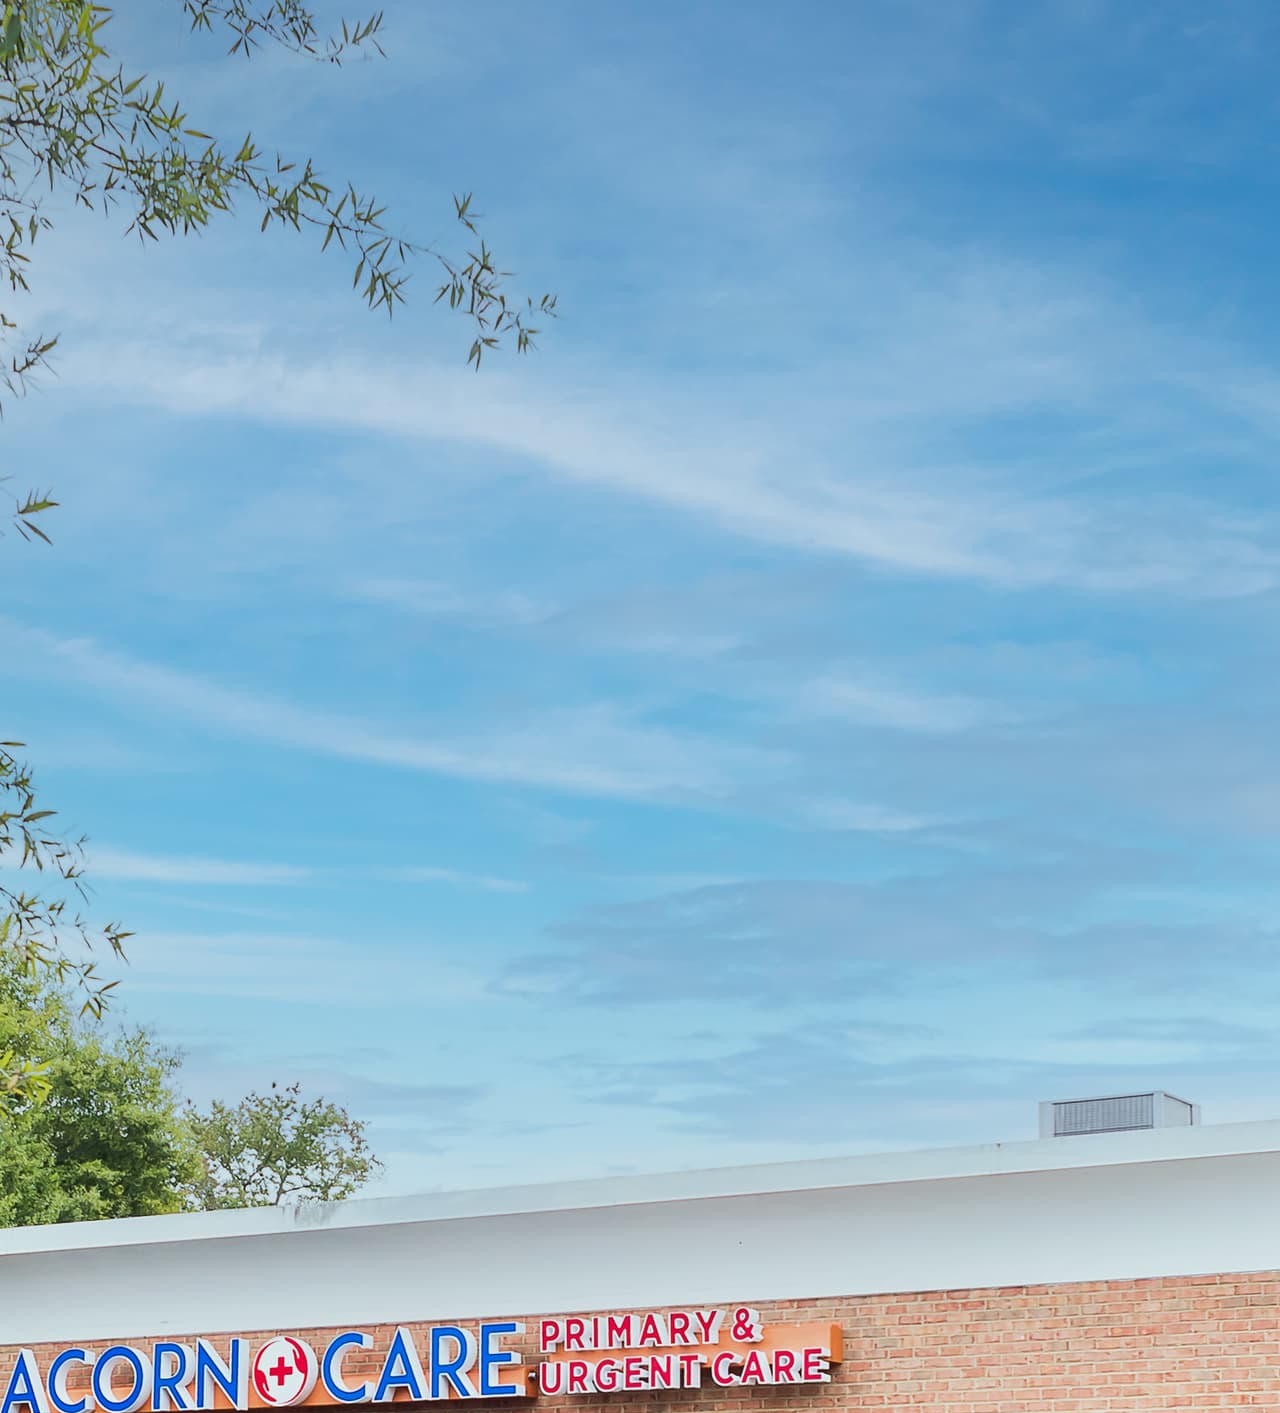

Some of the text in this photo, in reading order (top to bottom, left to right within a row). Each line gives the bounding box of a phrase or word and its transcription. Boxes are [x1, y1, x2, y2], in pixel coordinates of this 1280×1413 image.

[540, 1307, 760, 1352] PRIMARY &
[322, 1322, 521, 1403] CARE
[539, 1348, 827, 1395] URGENT CARE
